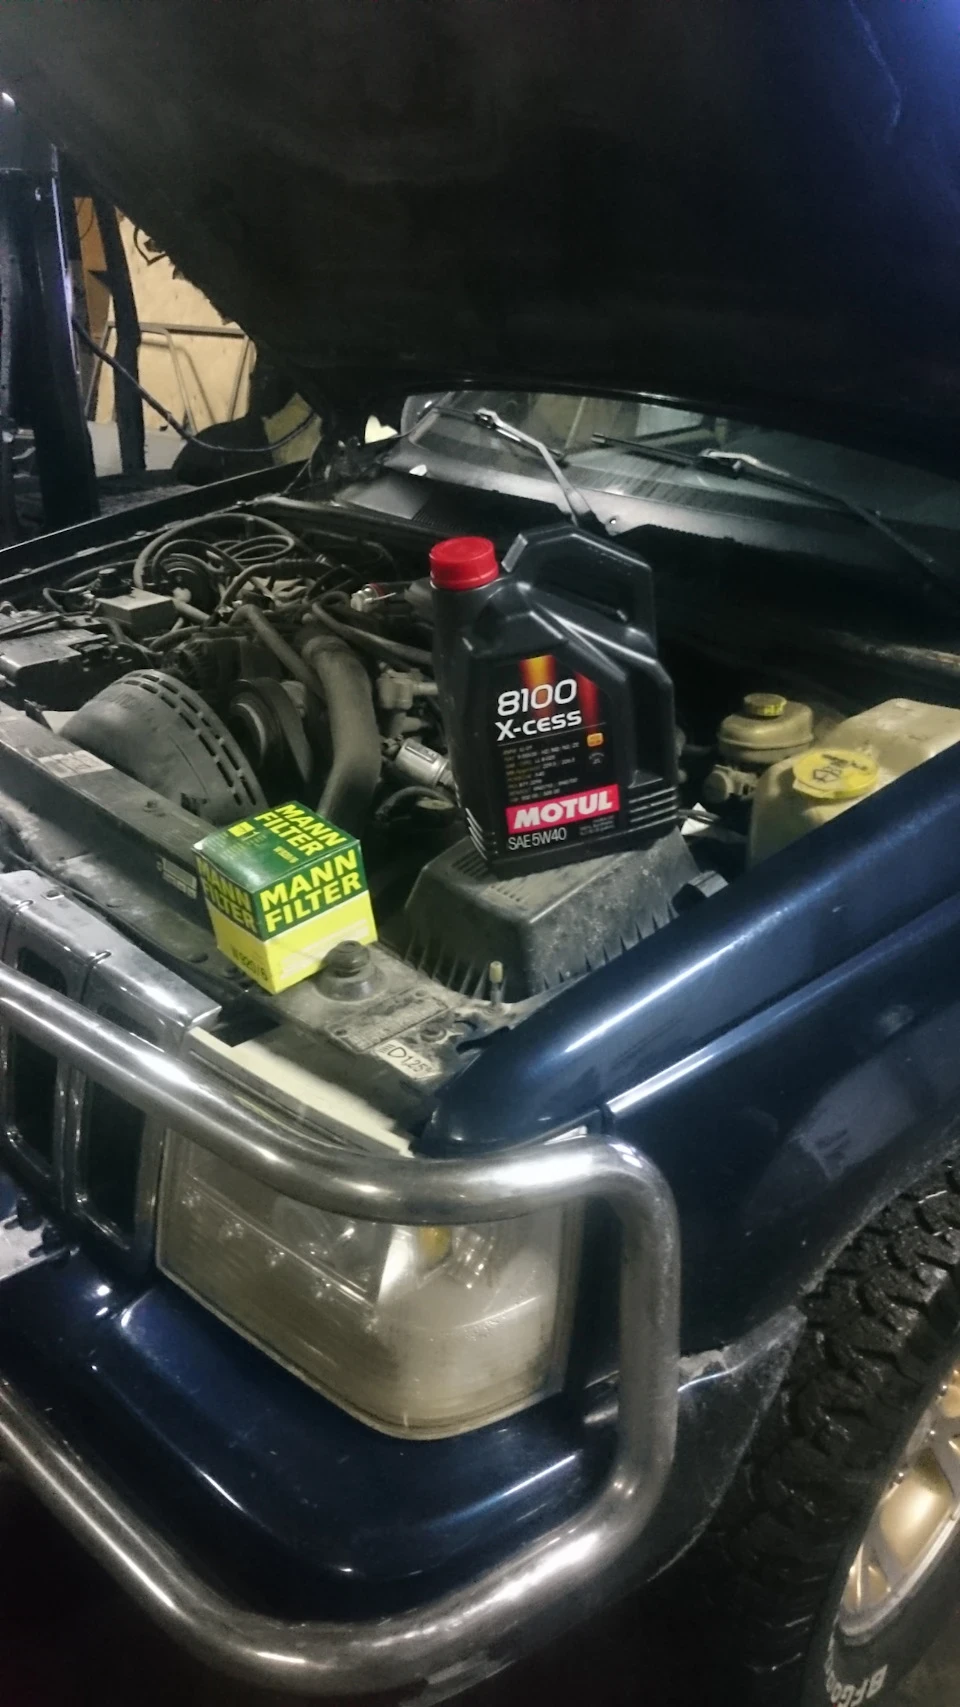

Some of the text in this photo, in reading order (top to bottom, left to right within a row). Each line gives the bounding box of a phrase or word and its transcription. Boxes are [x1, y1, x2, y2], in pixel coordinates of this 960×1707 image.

[497, 679, 577, 717] 8100
[275, 804, 347, 846] MANN
[514, 791, 612, 829] MOTUL
[254, 812, 324, 856] FILTER
[508, 827, 567, 851] SAE 5W40
[196, 856, 251, 911] MANN
[260, 849, 357, 912] MANN
[265, 872, 362, 933] FILTER
[201, 879, 258, 933] FILTER
